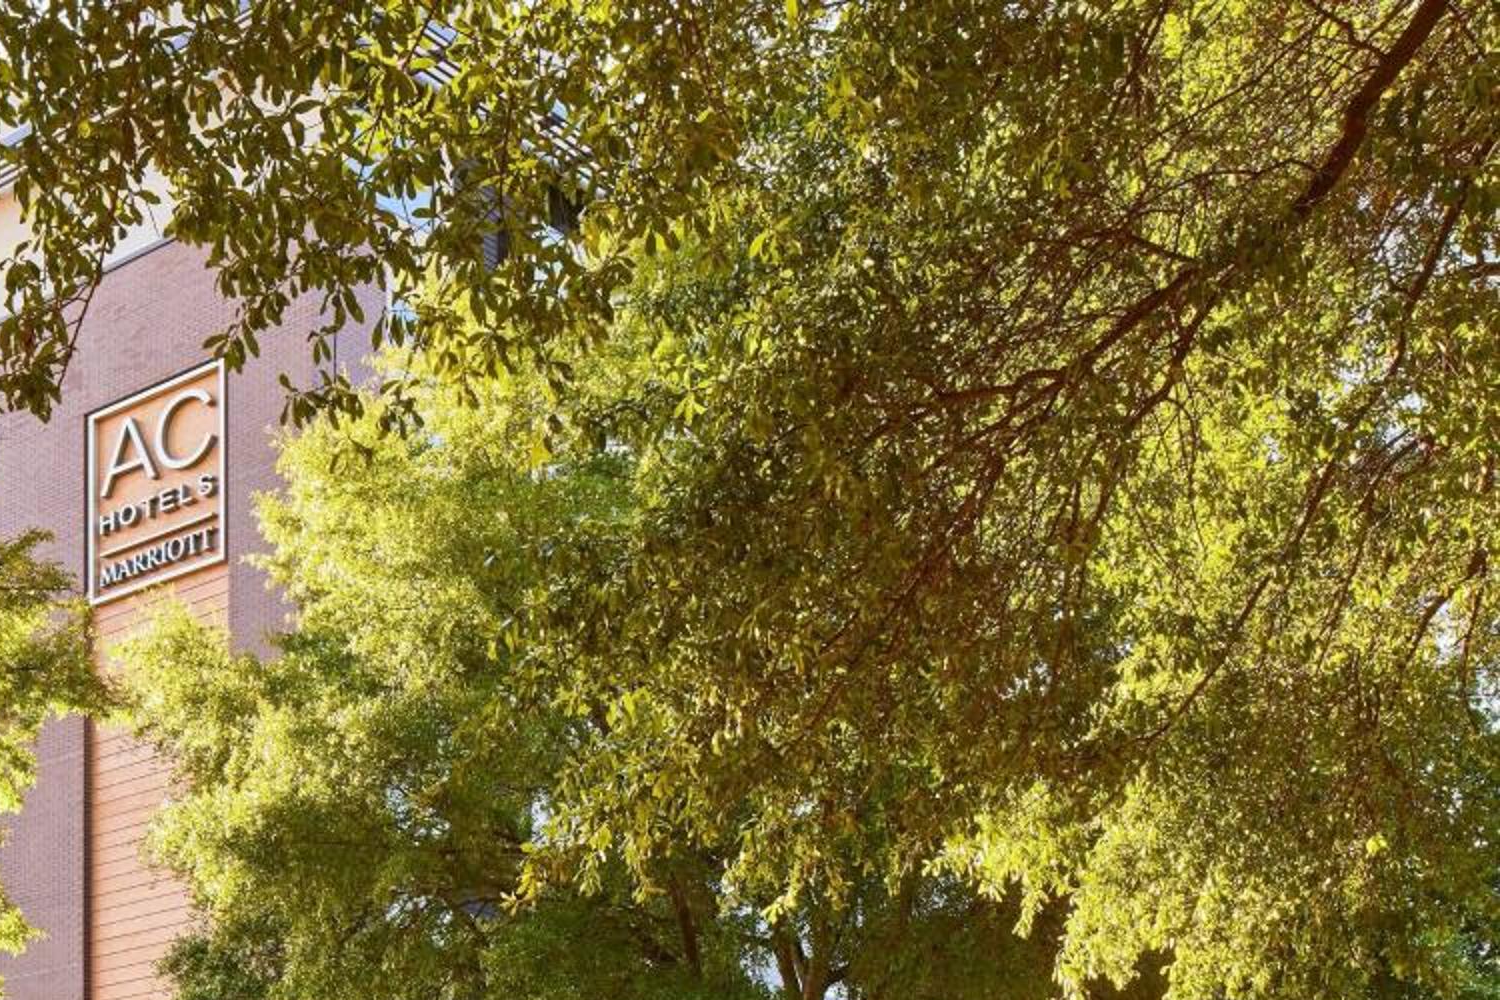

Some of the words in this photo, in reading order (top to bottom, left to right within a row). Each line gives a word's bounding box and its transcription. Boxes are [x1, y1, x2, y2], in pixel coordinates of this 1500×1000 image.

[102, 388, 216, 498] AC
[100, 474, 217, 536] HOTELS
[100, 528, 217, 587] MARRIOTT
